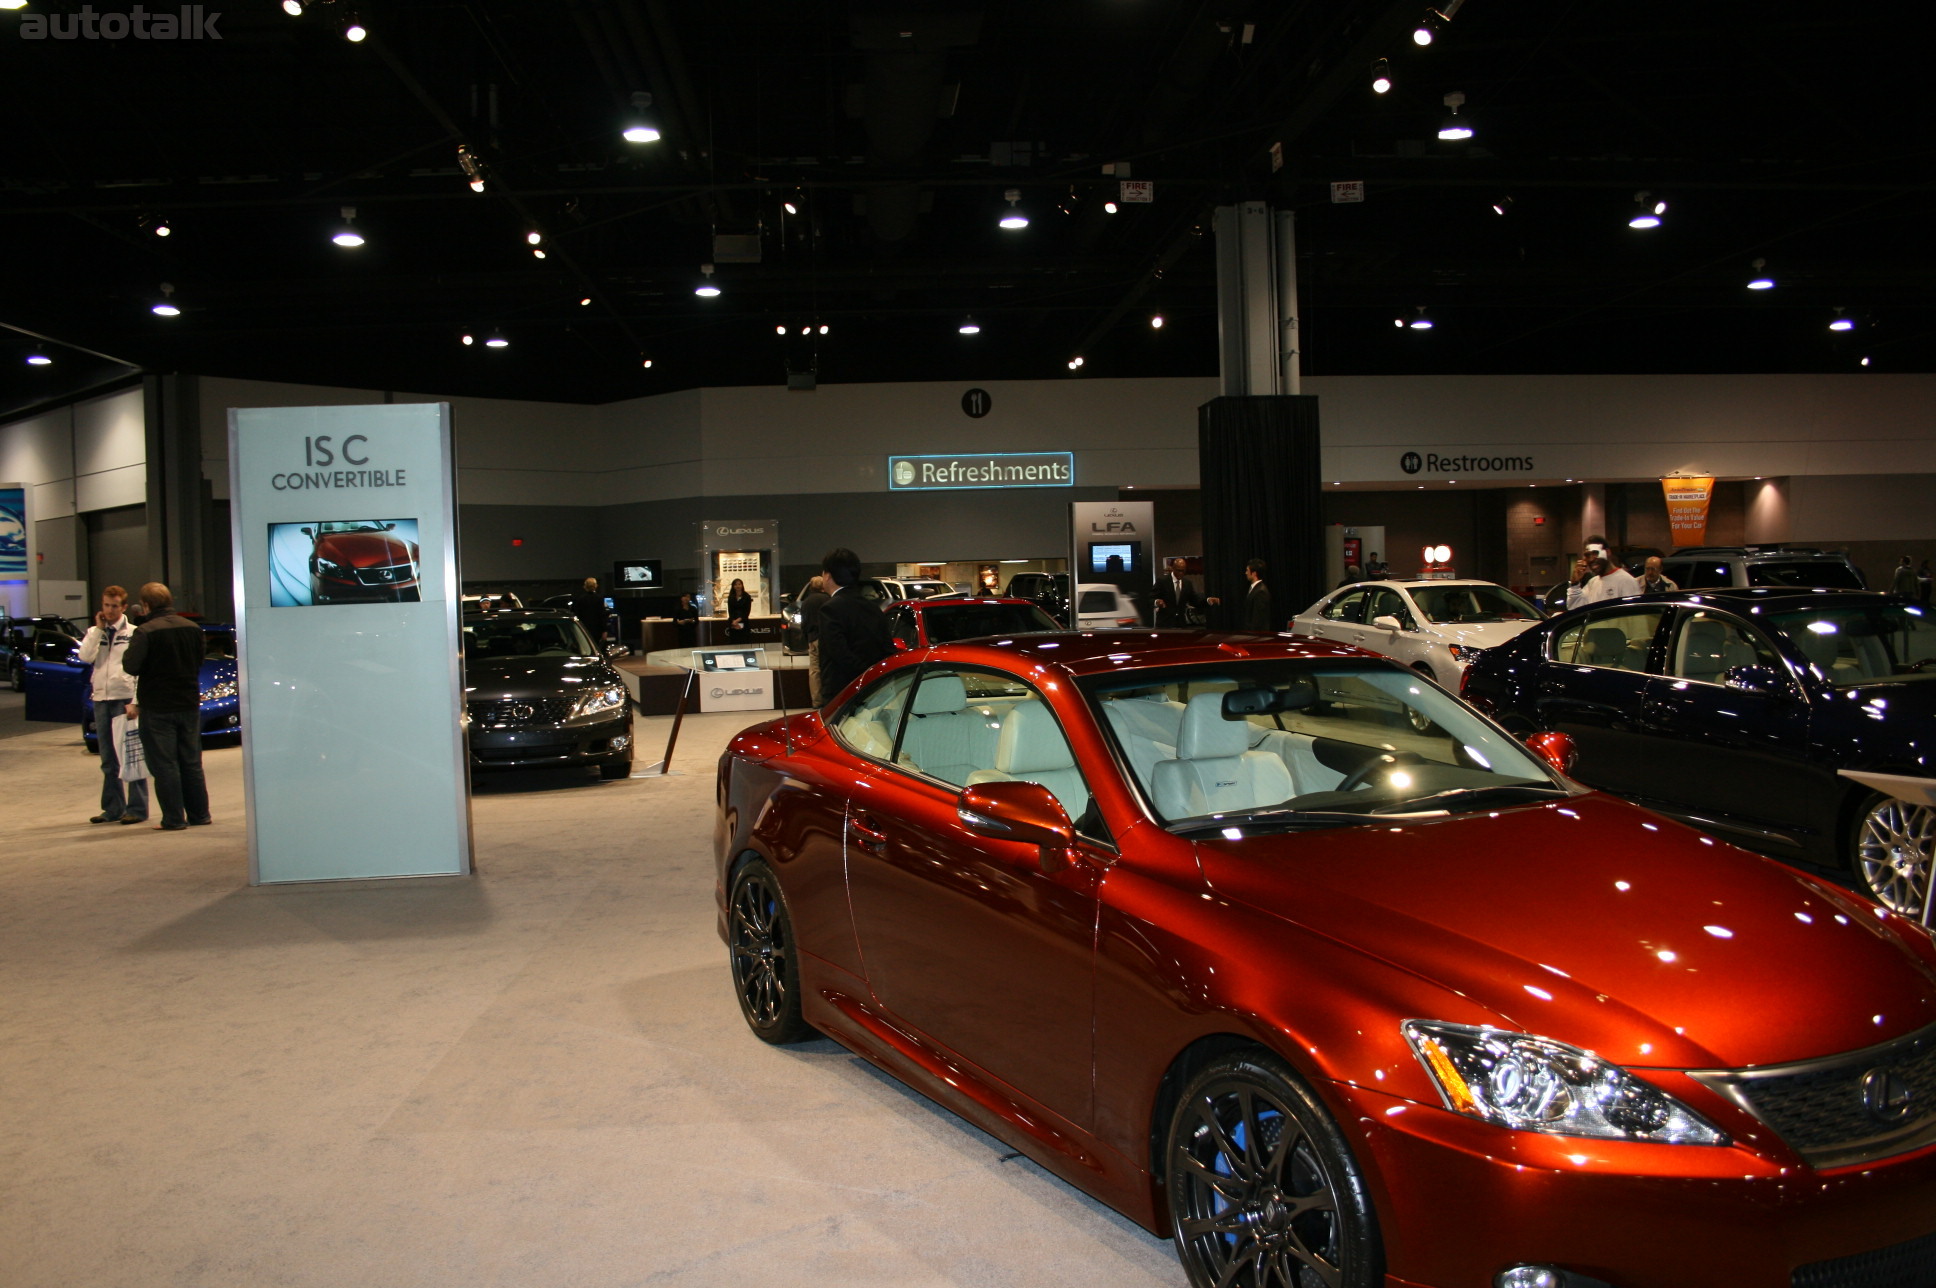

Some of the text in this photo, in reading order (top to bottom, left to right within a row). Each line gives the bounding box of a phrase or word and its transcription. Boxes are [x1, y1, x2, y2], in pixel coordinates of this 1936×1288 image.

[1126, 182, 1147, 190] FIRE
[1336, 183, 1358, 191] FIRE
[305, 434, 369, 467] IS C
[1426, 453, 1534, 472] Restrooms
[922, 460, 1070, 483] Refreshments
[271, 469, 406, 491] CONVERTIBLE
[729, 527, 765, 535] LEXUS
[1091, 521, 1136, 532] LFA
[725, 687, 764, 696] LEXUS
